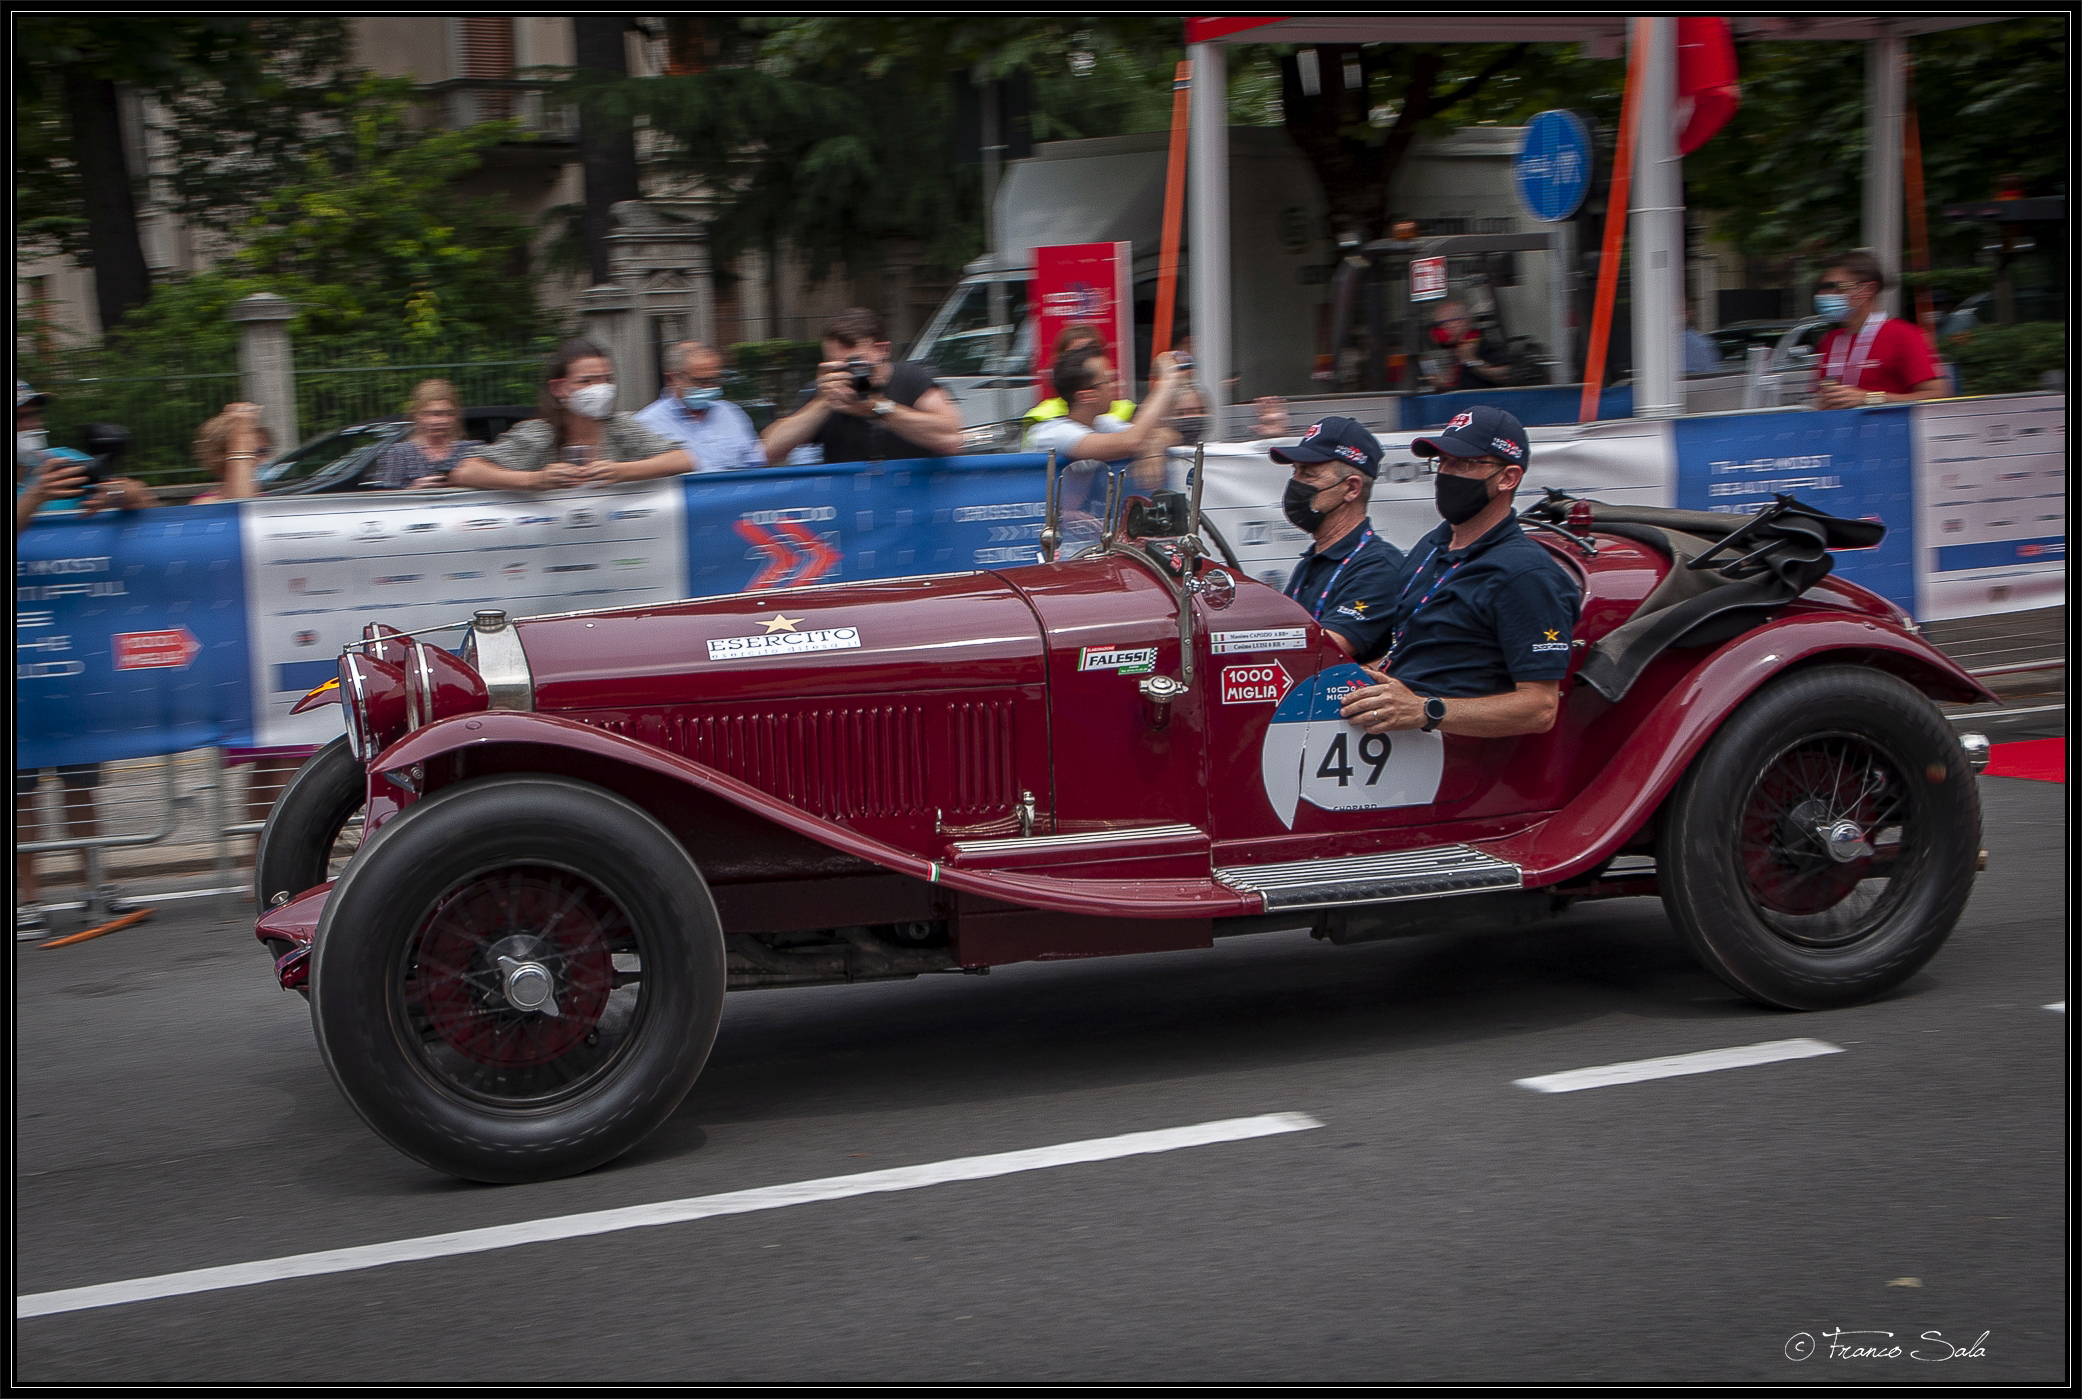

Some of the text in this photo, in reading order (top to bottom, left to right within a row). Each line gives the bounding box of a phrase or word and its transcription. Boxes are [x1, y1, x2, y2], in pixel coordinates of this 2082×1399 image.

[710, 628, 855, 652] ESERCITO
[1089, 651, 1148, 666] FALESSI
[1229, 669, 1274, 683] 1000
[1227, 685, 1278, 700] MIGLIA
[1326, 693, 1346, 701] MIG
[1316, 732, 1392, 787] 49
